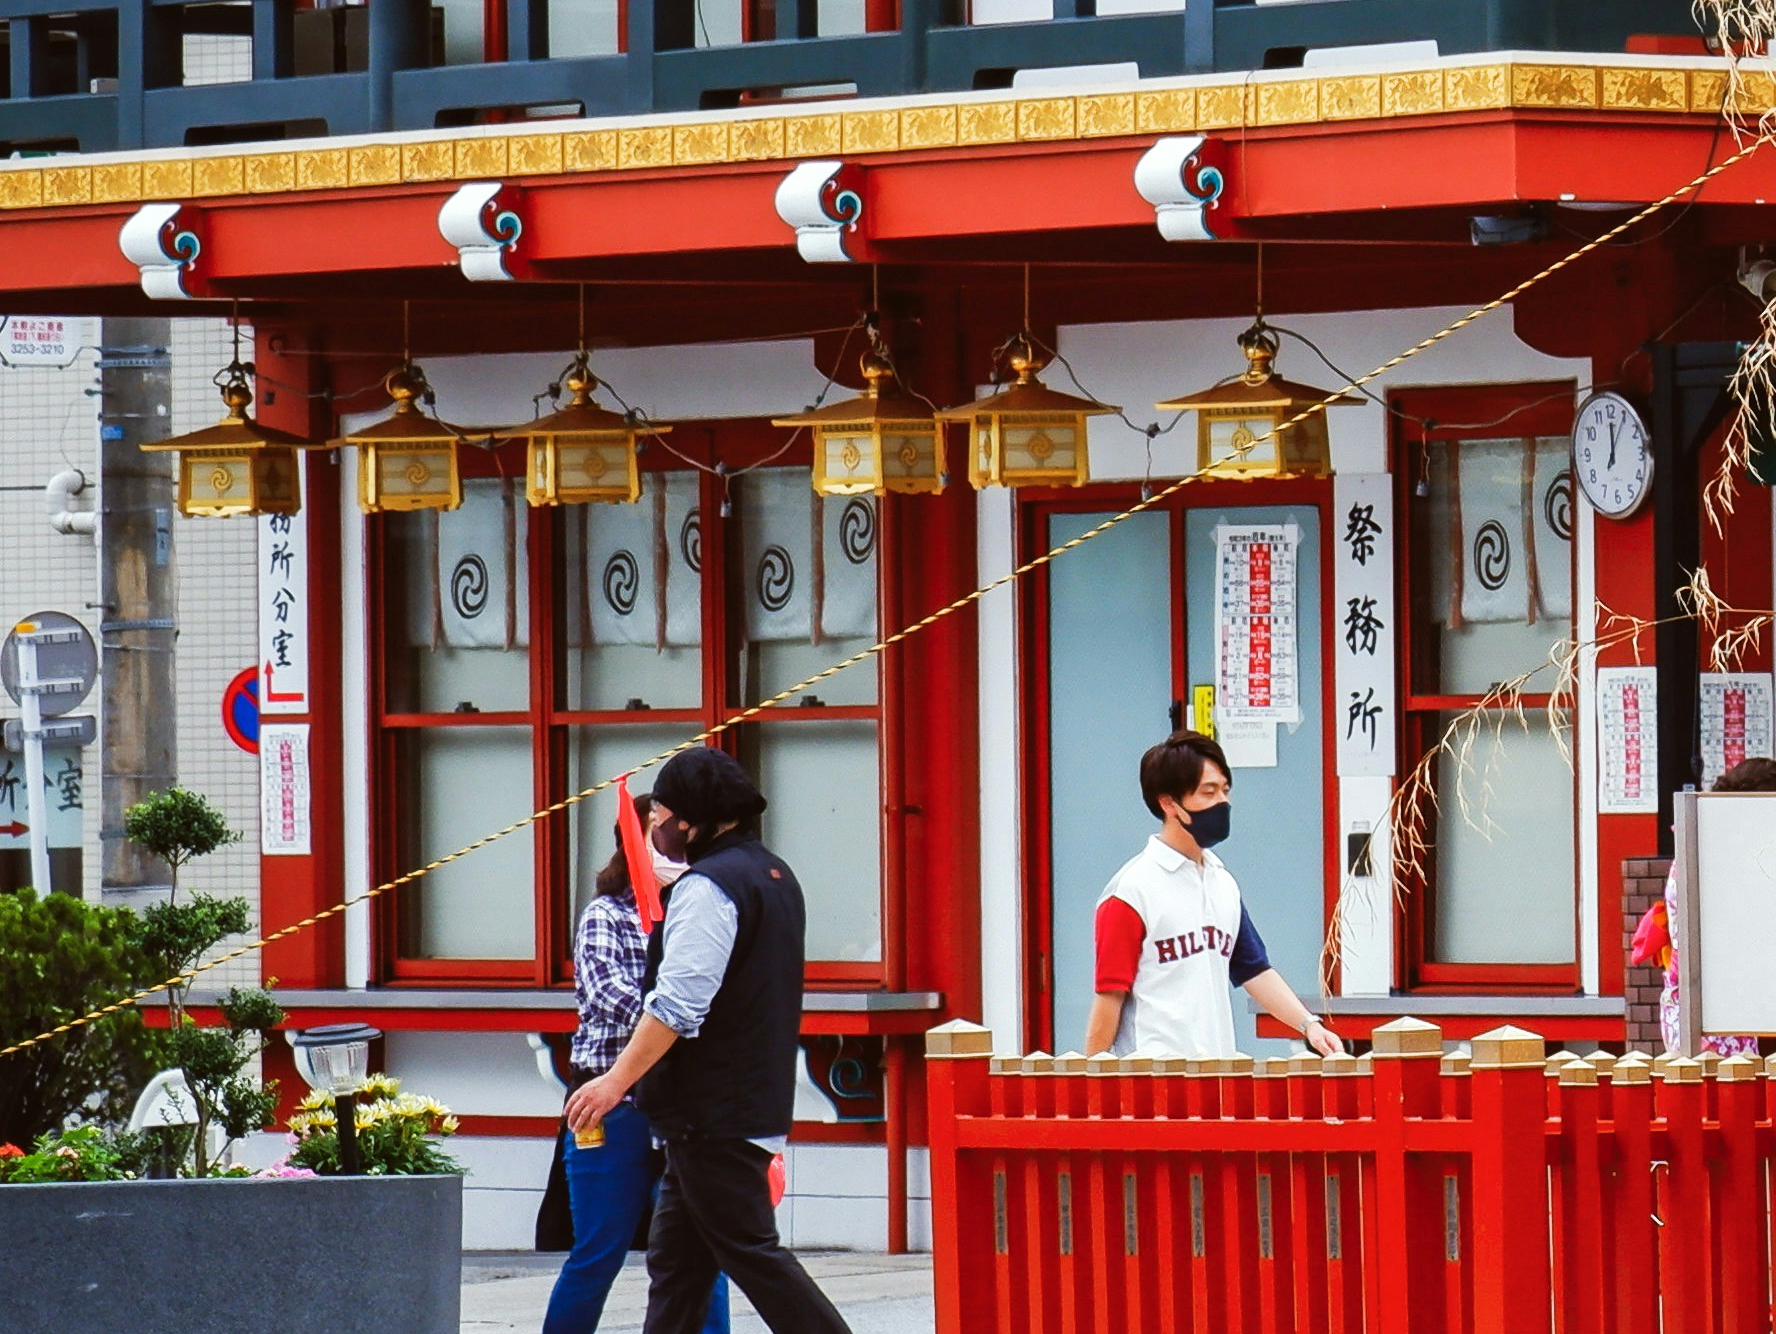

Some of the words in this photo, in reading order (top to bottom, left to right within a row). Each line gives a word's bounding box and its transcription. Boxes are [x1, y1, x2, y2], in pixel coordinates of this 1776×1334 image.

[1594, 410, 1603, 424] 11
[1605, 404, 1615, 419] 12
[1587, 427, 1597, 441] 10
[1631, 424, 1639, 439] 2
[1584, 447, 1591, 462] 9
[1638, 446, 1645, 461] 3
[1590, 469, 1597, 483] 8
[1635, 469, 1642, 483] 4
[1601, 484, 1607, 499] 7
[1614, 490, 1621, 505] 6
[1628, 485, 1634, 499] 5
[1343, 501, 1384, 752] 祭務所
